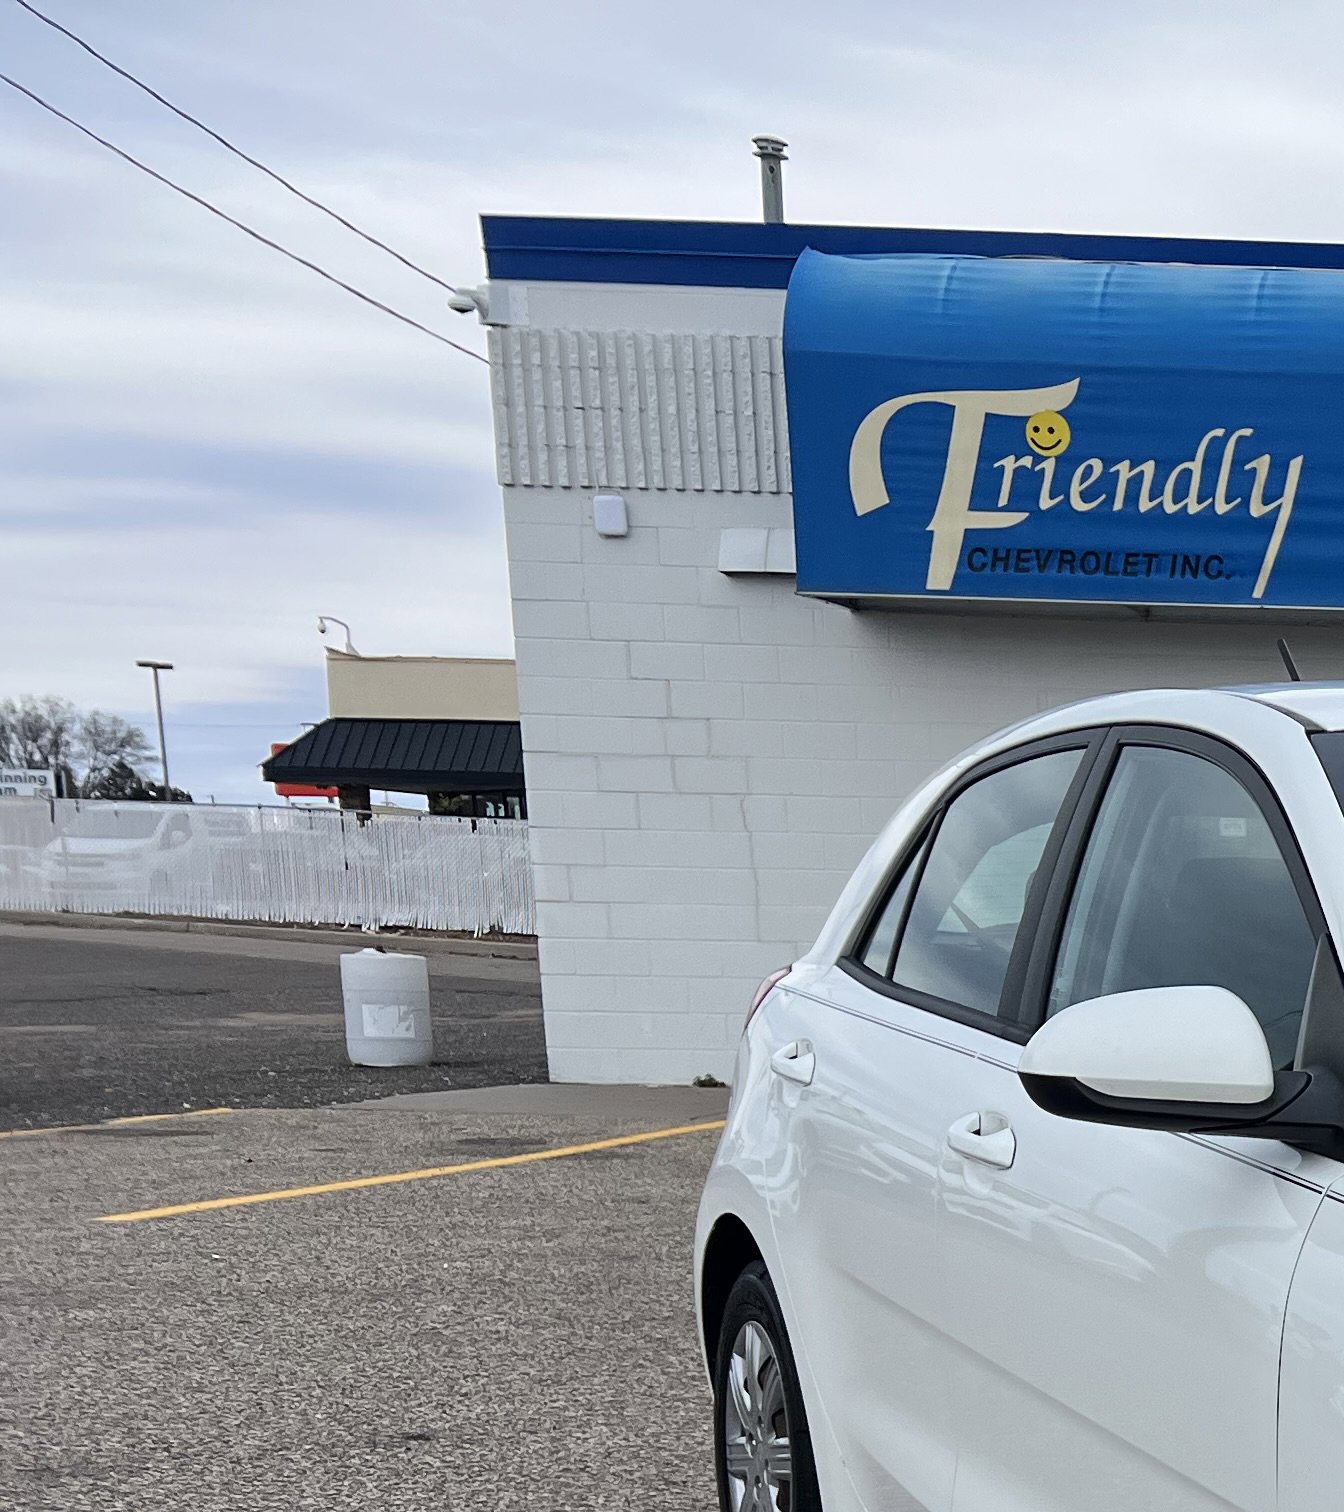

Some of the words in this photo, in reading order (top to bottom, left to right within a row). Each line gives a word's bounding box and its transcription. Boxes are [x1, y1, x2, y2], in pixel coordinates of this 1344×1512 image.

[848, 376, 1304, 599] Friendly
[966, 547, 1160, 578] CHEVROLET
[1168, 553, 1233, 581] INC.
